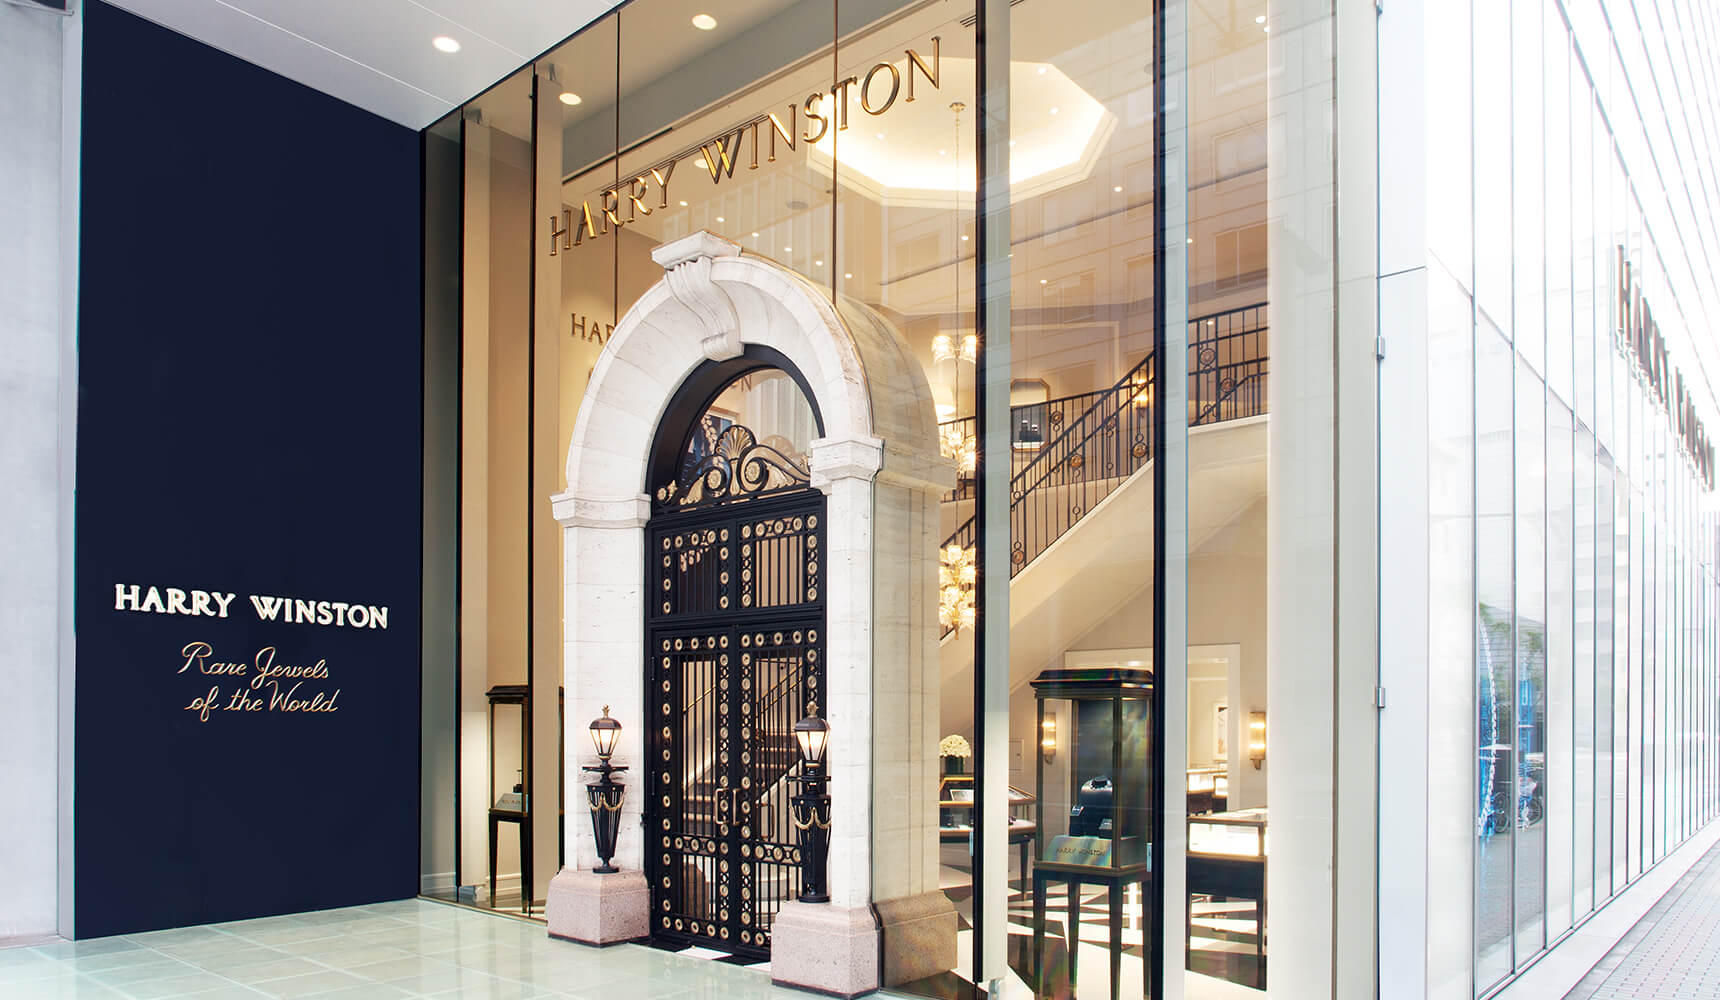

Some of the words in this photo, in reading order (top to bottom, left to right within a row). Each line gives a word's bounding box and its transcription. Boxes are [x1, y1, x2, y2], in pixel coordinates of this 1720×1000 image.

[550, 159, 678, 257] HARRY
[700, 36, 941, 184] WINSTON
[114, 583, 237, 619] HARRY
[249, 595, 389, 630] WINSTON
[177, 641, 248, 675] Rare
[251, 646, 330, 690] Jewels
[184, 685, 220, 723] of
[223, 688, 264, 712] the
[265, 680, 341, 713] World
